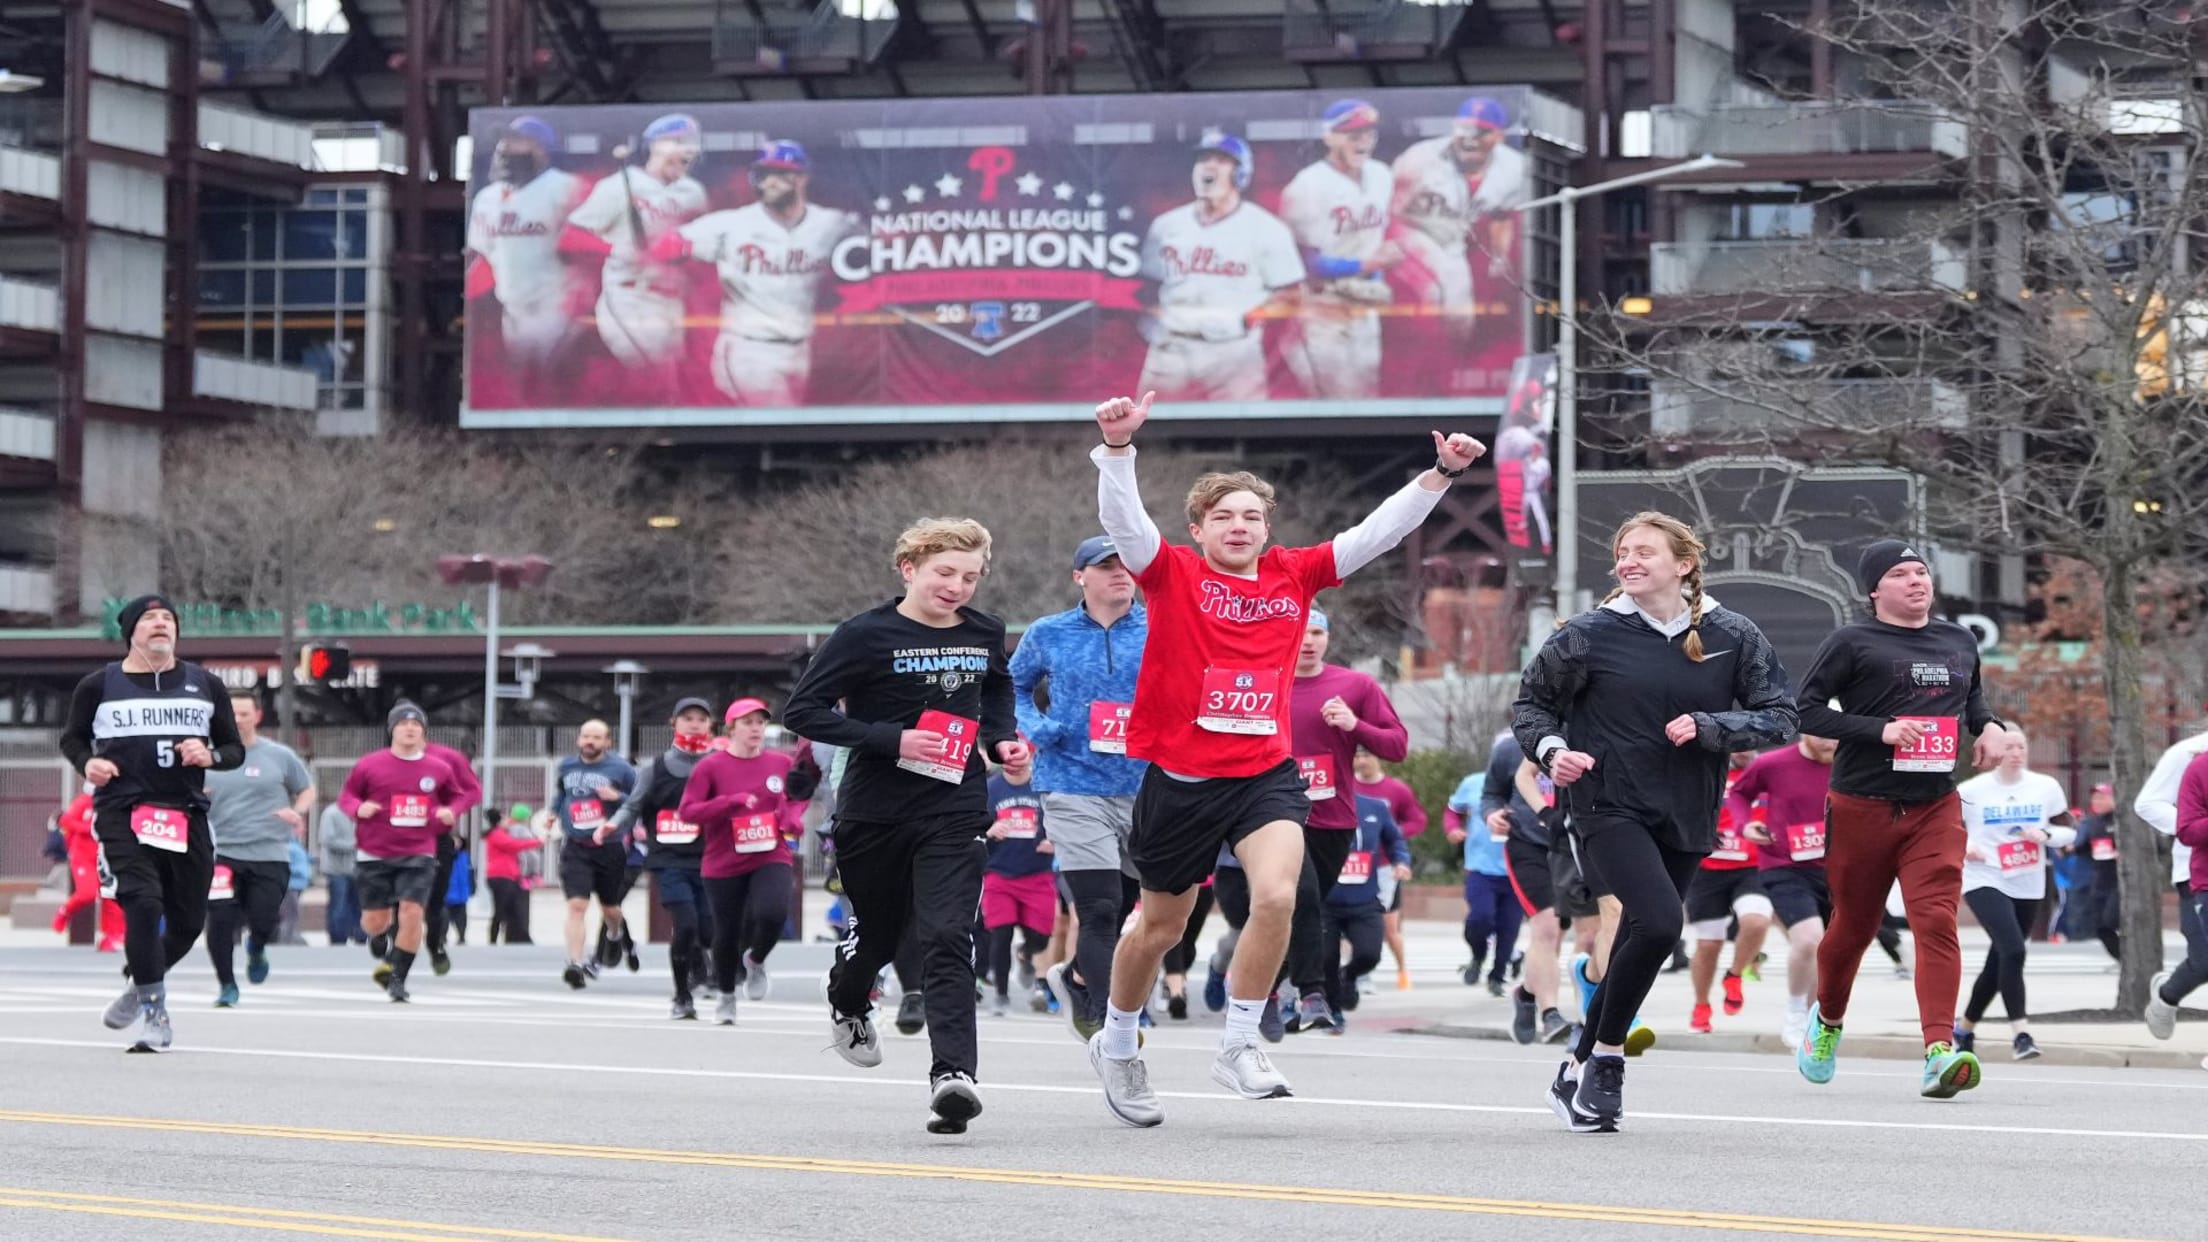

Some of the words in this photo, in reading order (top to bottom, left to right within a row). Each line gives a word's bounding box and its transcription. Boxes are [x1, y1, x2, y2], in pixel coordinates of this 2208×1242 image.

[871, 209, 1003, 235] NATIONAL
[1008, 209, 1108, 232] LEAGUE
[831, 232, 1142, 281] CHAMPIONS
[1160, 244, 1249, 277] Phillies
[935, 303, 965, 323] 20
[1011, 302, 1042, 322] 22
[1200, 579, 1301, 622] Phillies
[306, 600, 391, 630] Bank
[401, 600, 480, 630] Park
[893, 648, 939, 658] EASTERN
[893, 656, 988, 673] CHAMPIONS
[925, 675, 937, 684] 20
[964, 674, 975, 683] 22
[1207, 690, 1275, 712] 3707
[111, 708, 137, 728] S.J.
[142, 706, 205, 728] RUNNERS
[1101, 718, 1127, 738] 71
[156, 739, 175, 769] 5
[940, 736, 973, 763] 419
[1299, 769, 1328, 785] 73
[141, 819, 178, 839] 204
[737, 825, 776, 841] 2601
[2002, 849, 2038, 866] 4804
